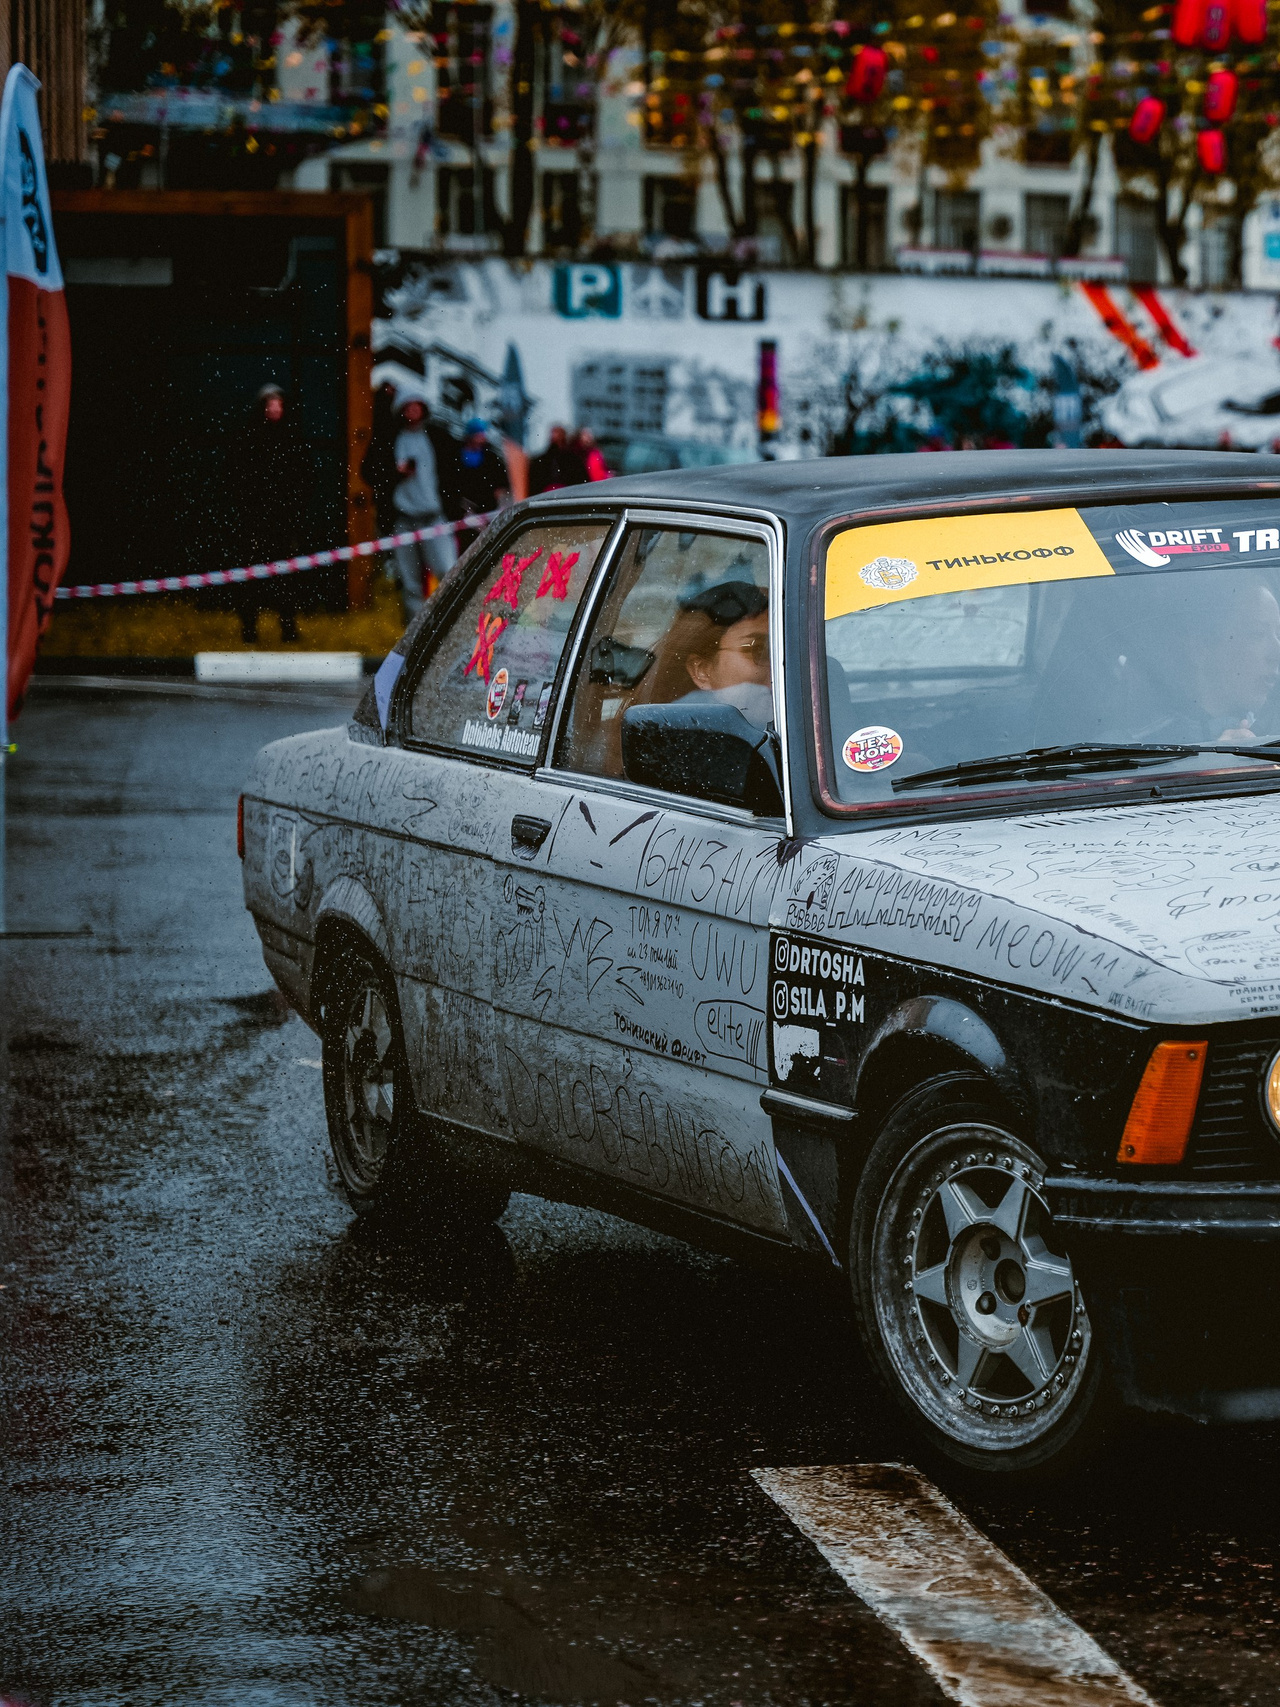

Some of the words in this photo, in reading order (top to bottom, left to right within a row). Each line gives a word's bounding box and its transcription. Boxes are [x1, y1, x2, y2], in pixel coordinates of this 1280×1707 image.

[1149, 528, 1223, 549] DRIFT
[1191, 543, 1226, 553] EXPO
[926, 544, 1075, 572] ТИНЬКОФФ
[855, 743, 894, 763] КОМ
[857, 733, 888, 752] ТЕХ
[976, 915, 1086, 984] MEOW
[789, 944, 866, 987] DRTOSHA
